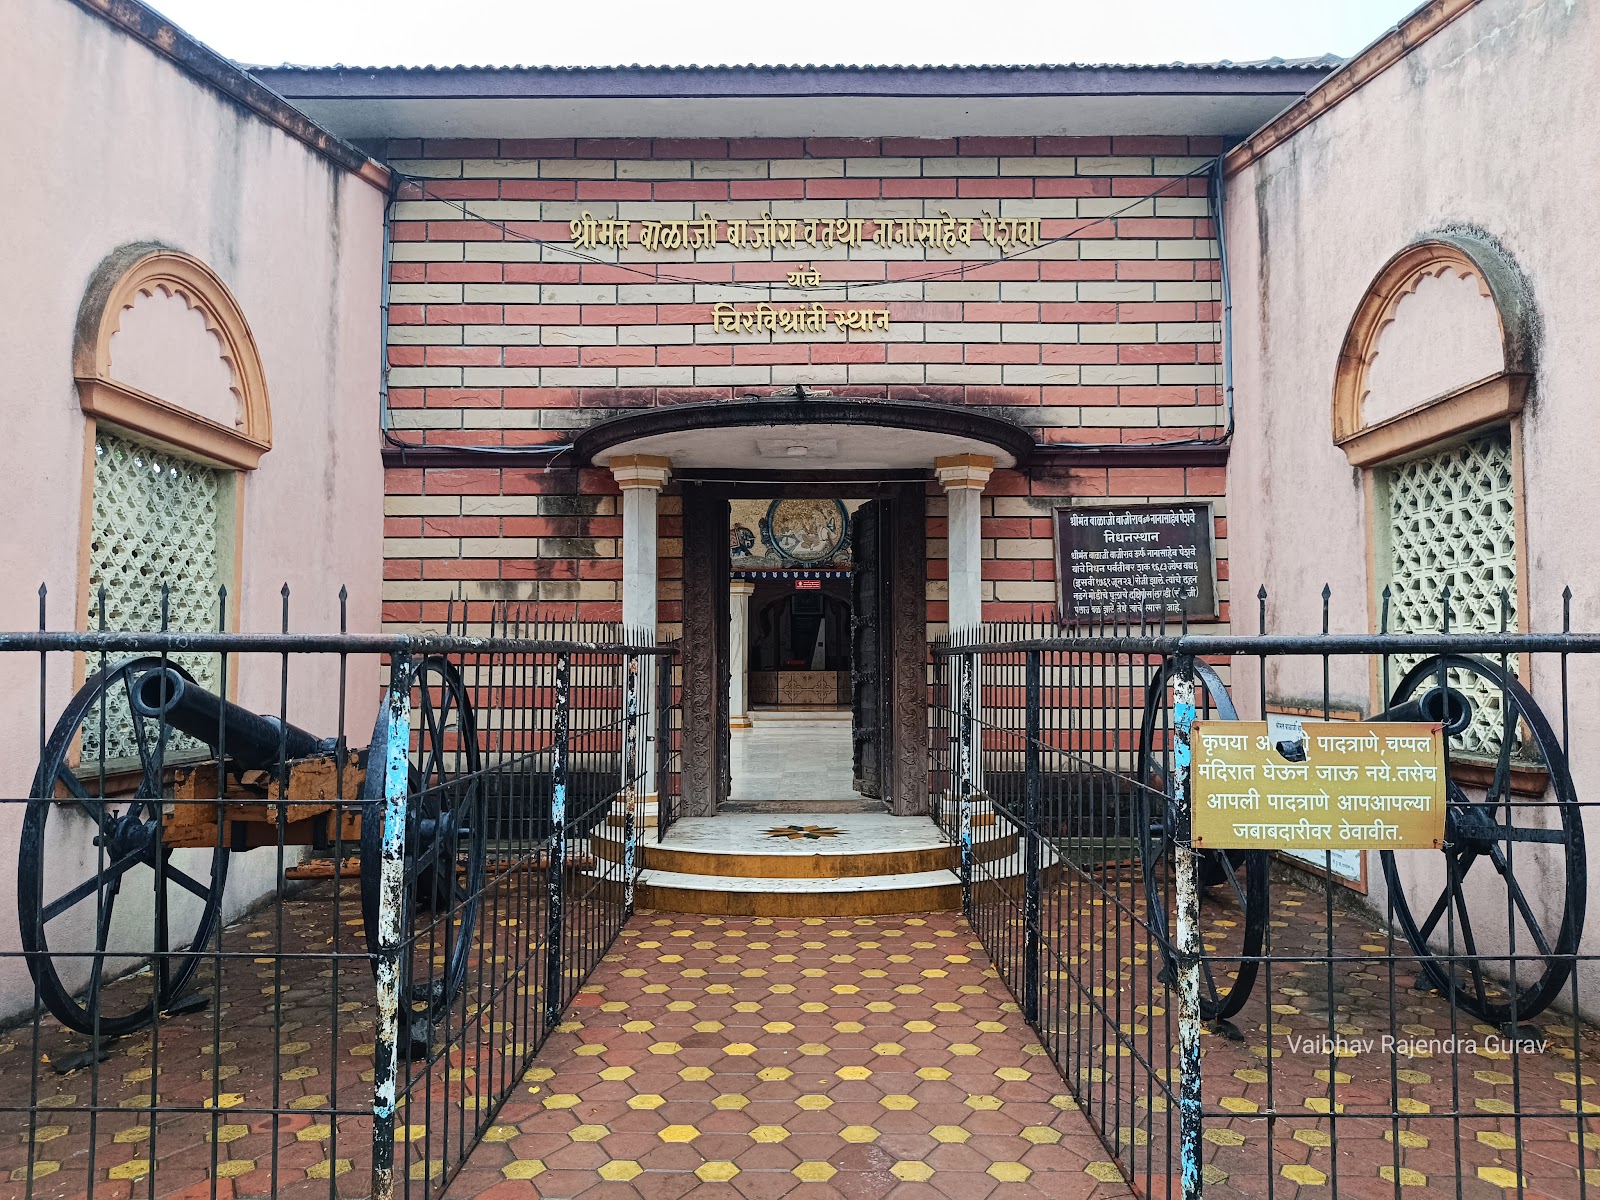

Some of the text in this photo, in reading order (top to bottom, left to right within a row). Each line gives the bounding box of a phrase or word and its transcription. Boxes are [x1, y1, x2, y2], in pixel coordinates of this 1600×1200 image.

[569, 210, 630, 249] श्रीमंत
[639, 210, 718, 251] बाळाजी
[872, 208, 974, 254] नानासाहेब
[980, 209, 1041, 253] पेशवा
[786, 264, 821, 287] यांचे
[711, 302, 890, 334] चिरविश्रांती स्थान
[1070, 514, 1088, 527] श्रीमंत
[1103, 530, 1160, 543] निधनस्थान
[1202, 734, 1249, 756] कृपया
[1198, 758, 1256, 782] मंदिरात
[1262, 758, 1309, 782] घेऊन
[1315, 765, 1359, 782] जाऊ
[1206, 787, 1431, 812] आपली पादत्राणे आपआपल्या
[1232, 818, 1403, 841] जबाबदारीवर ठेवावीत.
